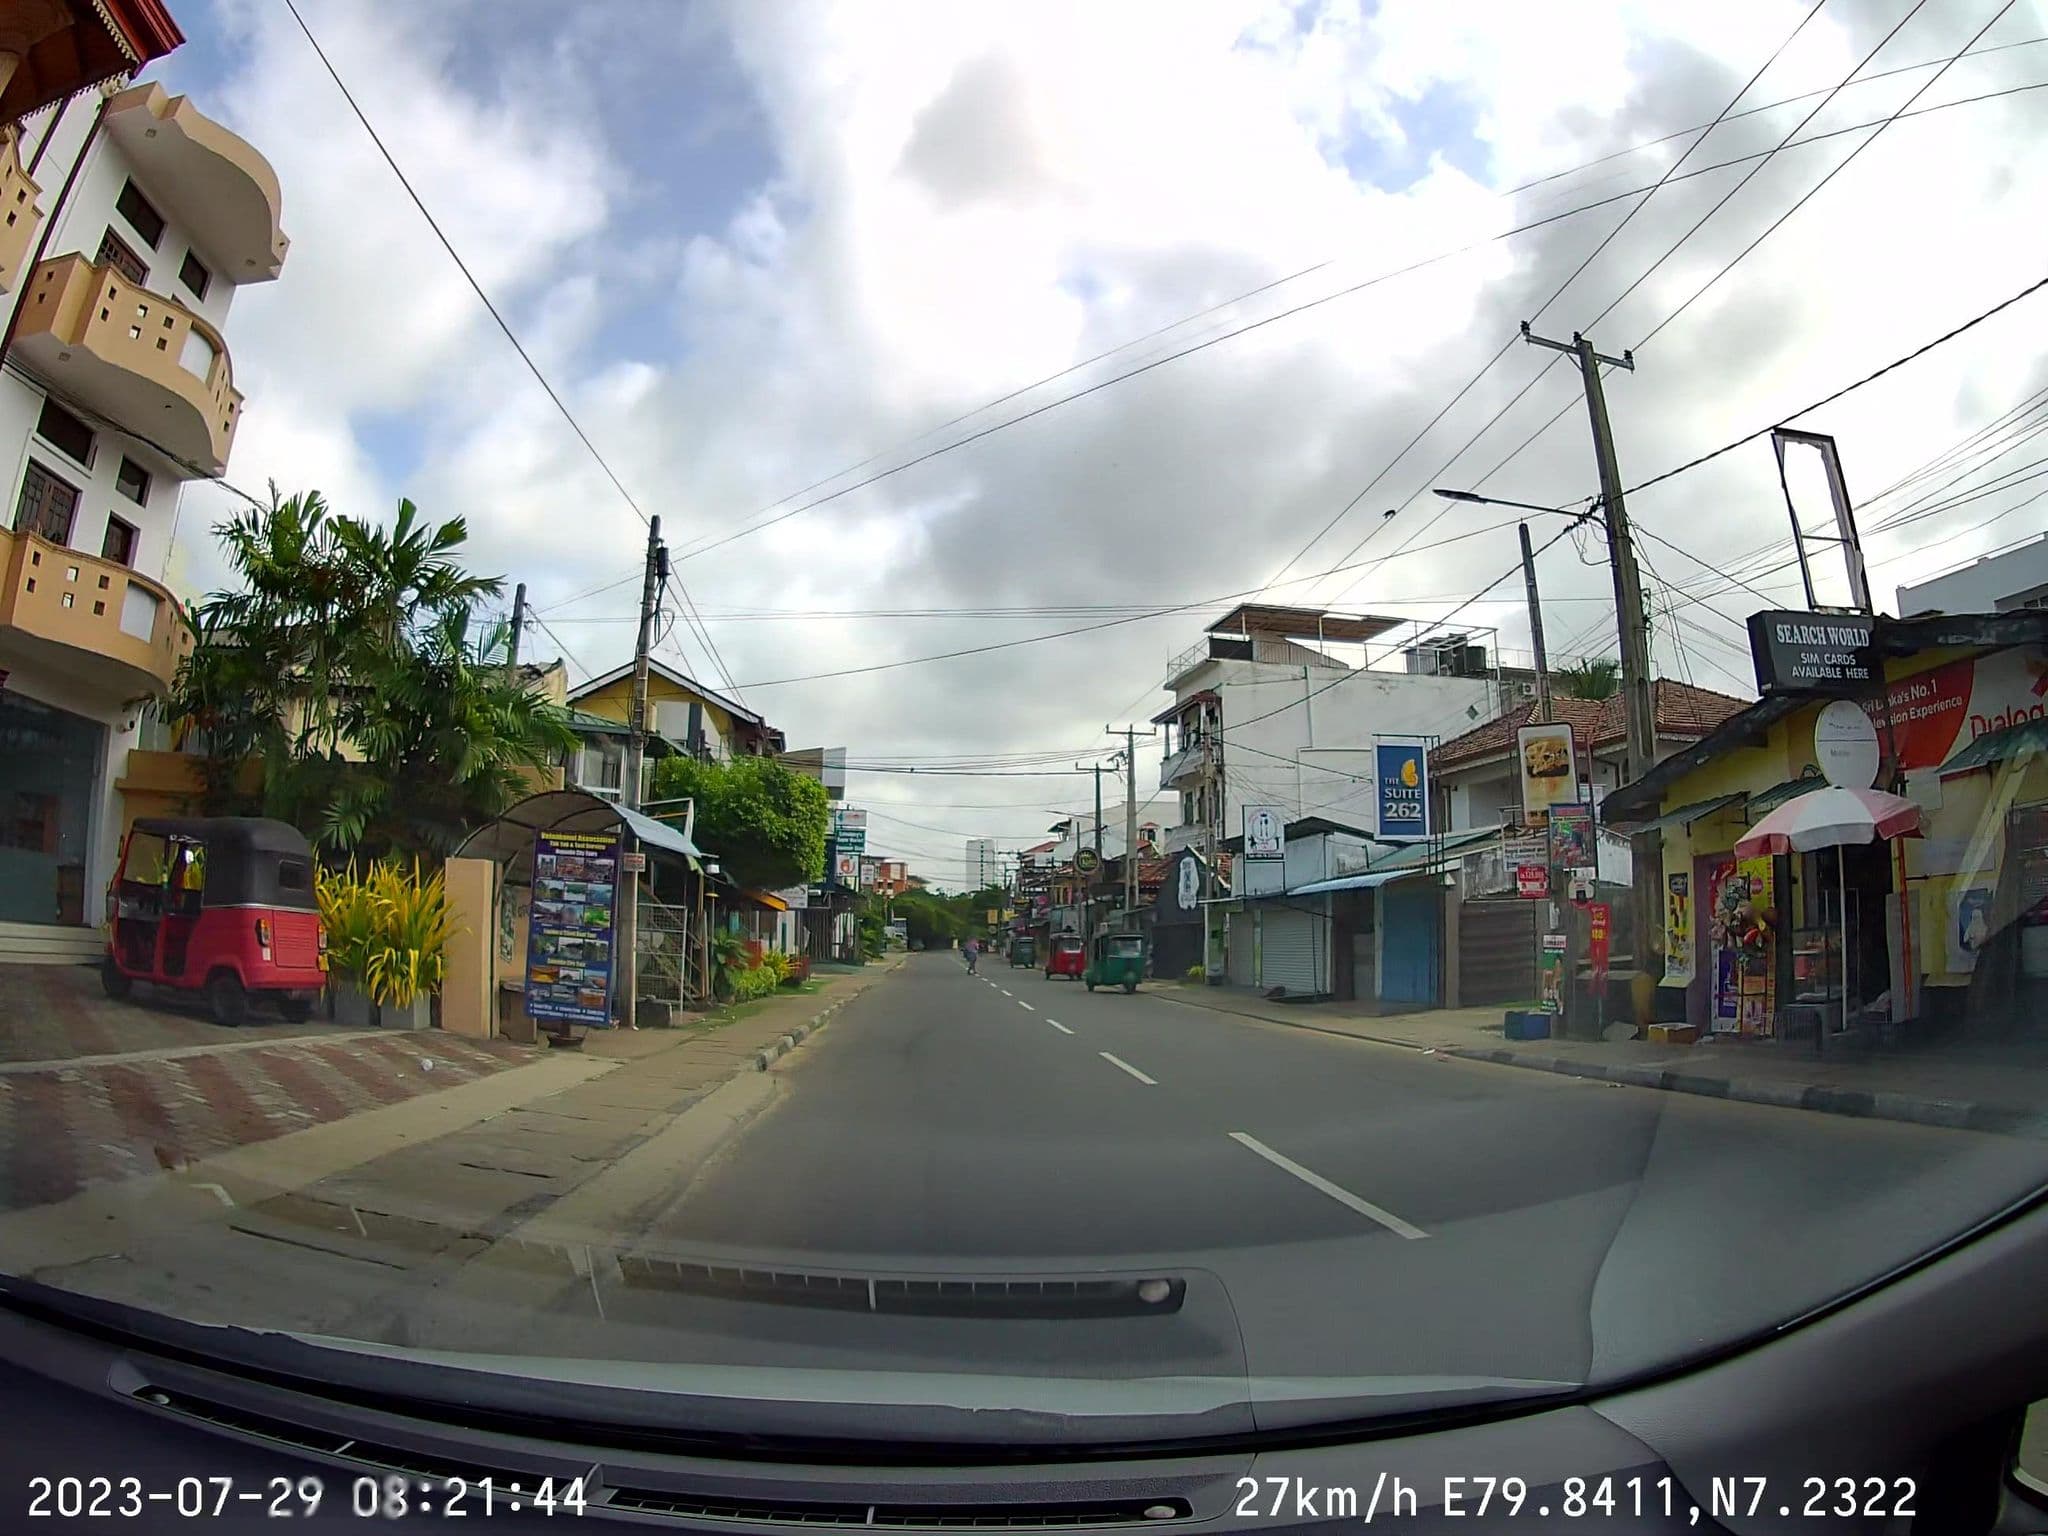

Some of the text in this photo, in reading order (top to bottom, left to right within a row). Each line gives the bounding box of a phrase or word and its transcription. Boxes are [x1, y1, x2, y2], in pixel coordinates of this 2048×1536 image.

[1776, 624, 1870, 647] SEARCH WORLD
[1800, 652, 1856, 665] SIM CARDS
[1791, 666, 1869, 679] AVAILABLE HERE
[1909, 696, 1963, 720] Experience
[1384, 787, 1422, 800] SUITE
[1384, 802, 1421, 818] 262
